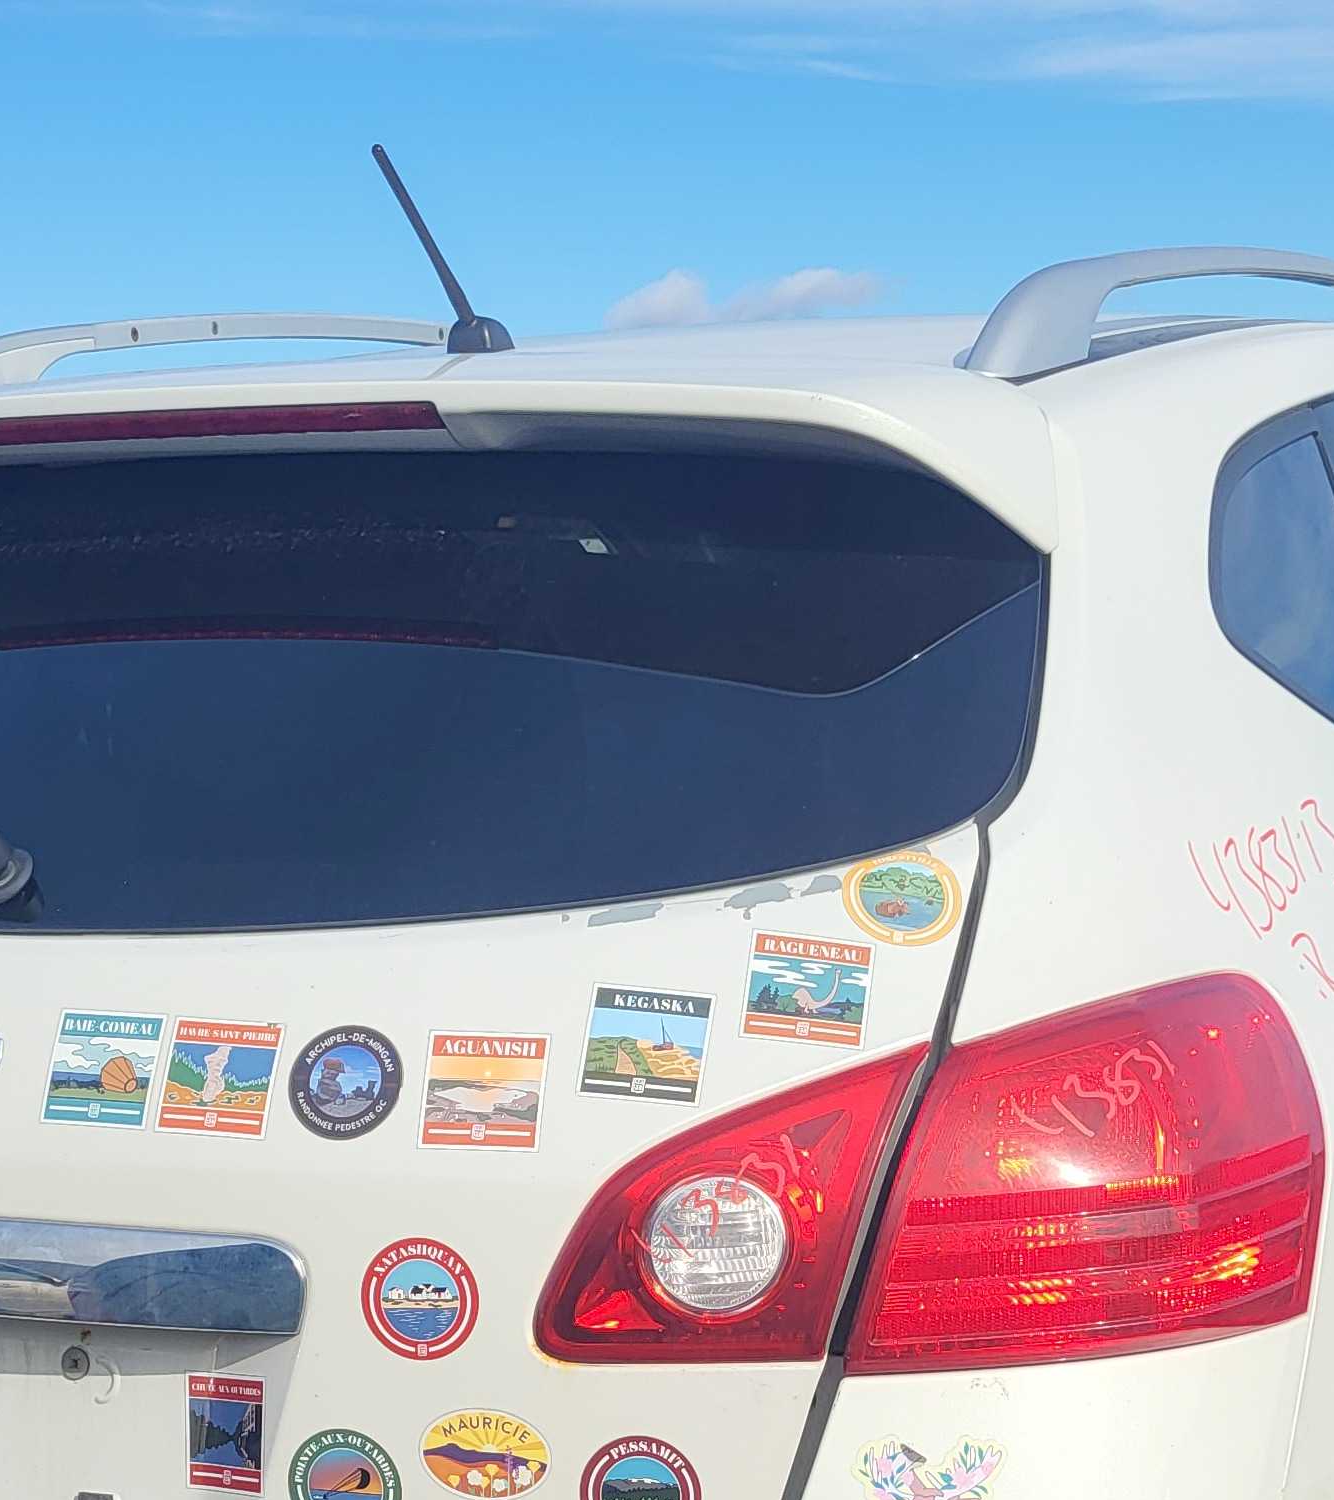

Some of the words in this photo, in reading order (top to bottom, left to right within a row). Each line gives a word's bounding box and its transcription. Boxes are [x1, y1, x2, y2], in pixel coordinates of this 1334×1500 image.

[763, 938, 864, 962] RAGUENEAU
[612, 993, 695, 1014] KEGASKA
[63, 1017, 159, 1037] BAIE-COMEAU
[304, 1032, 396, 1074] ARCHIPEL-DE-MINGAN
[440, 1038, 538, 1058] AGUANISH
[372, 1243, 465, 1276] NATASHQUAN
[441, 1415, 531, 1444] MAURICIE
[608, 1440, 686, 1470] PESSAMIT
